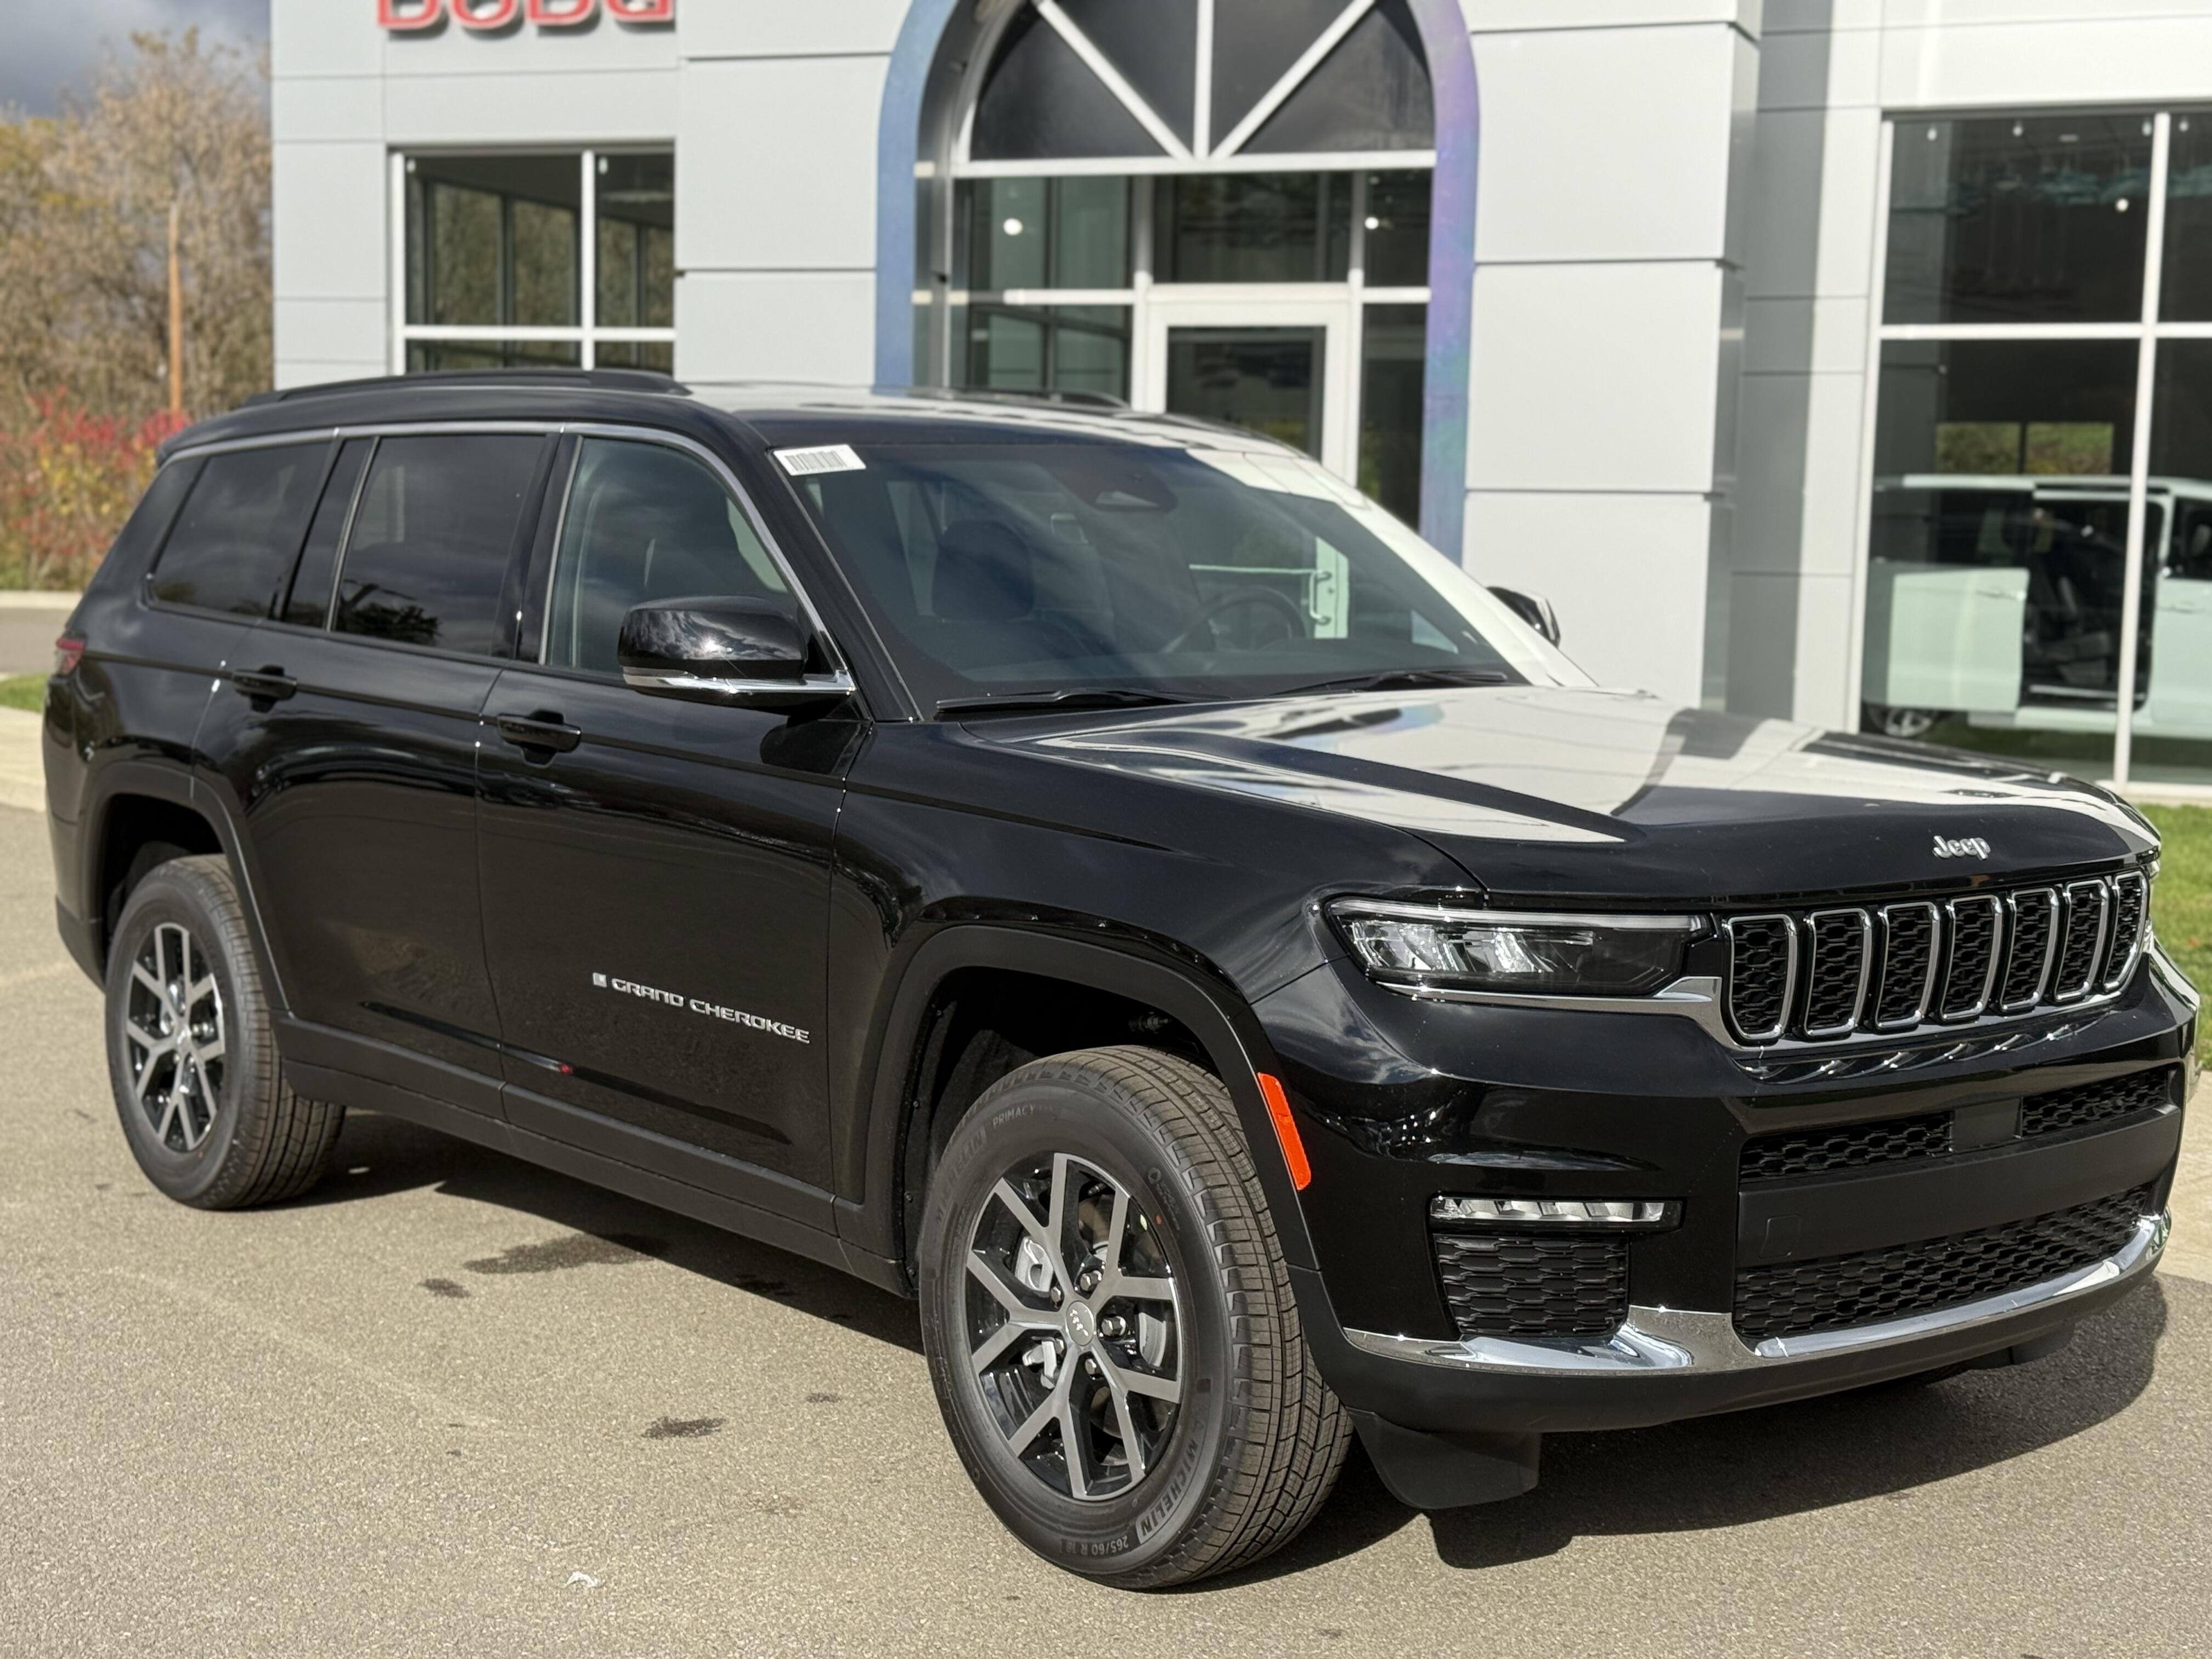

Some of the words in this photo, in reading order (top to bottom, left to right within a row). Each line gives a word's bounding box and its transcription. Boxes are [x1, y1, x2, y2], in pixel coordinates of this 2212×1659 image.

[1932, 836, 1991, 860] Jeep
[612, 978, 684, 1007] GRAND
[690, 998, 810, 1043] CHEROKEE
[992, 1104, 1035, 1128] PRIMACY
[1141, 1440, 1198, 1536] MICHELIN
[1081, 1543, 1088, 1555] R
[1091, 1535, 1128, 1555] 265/60
